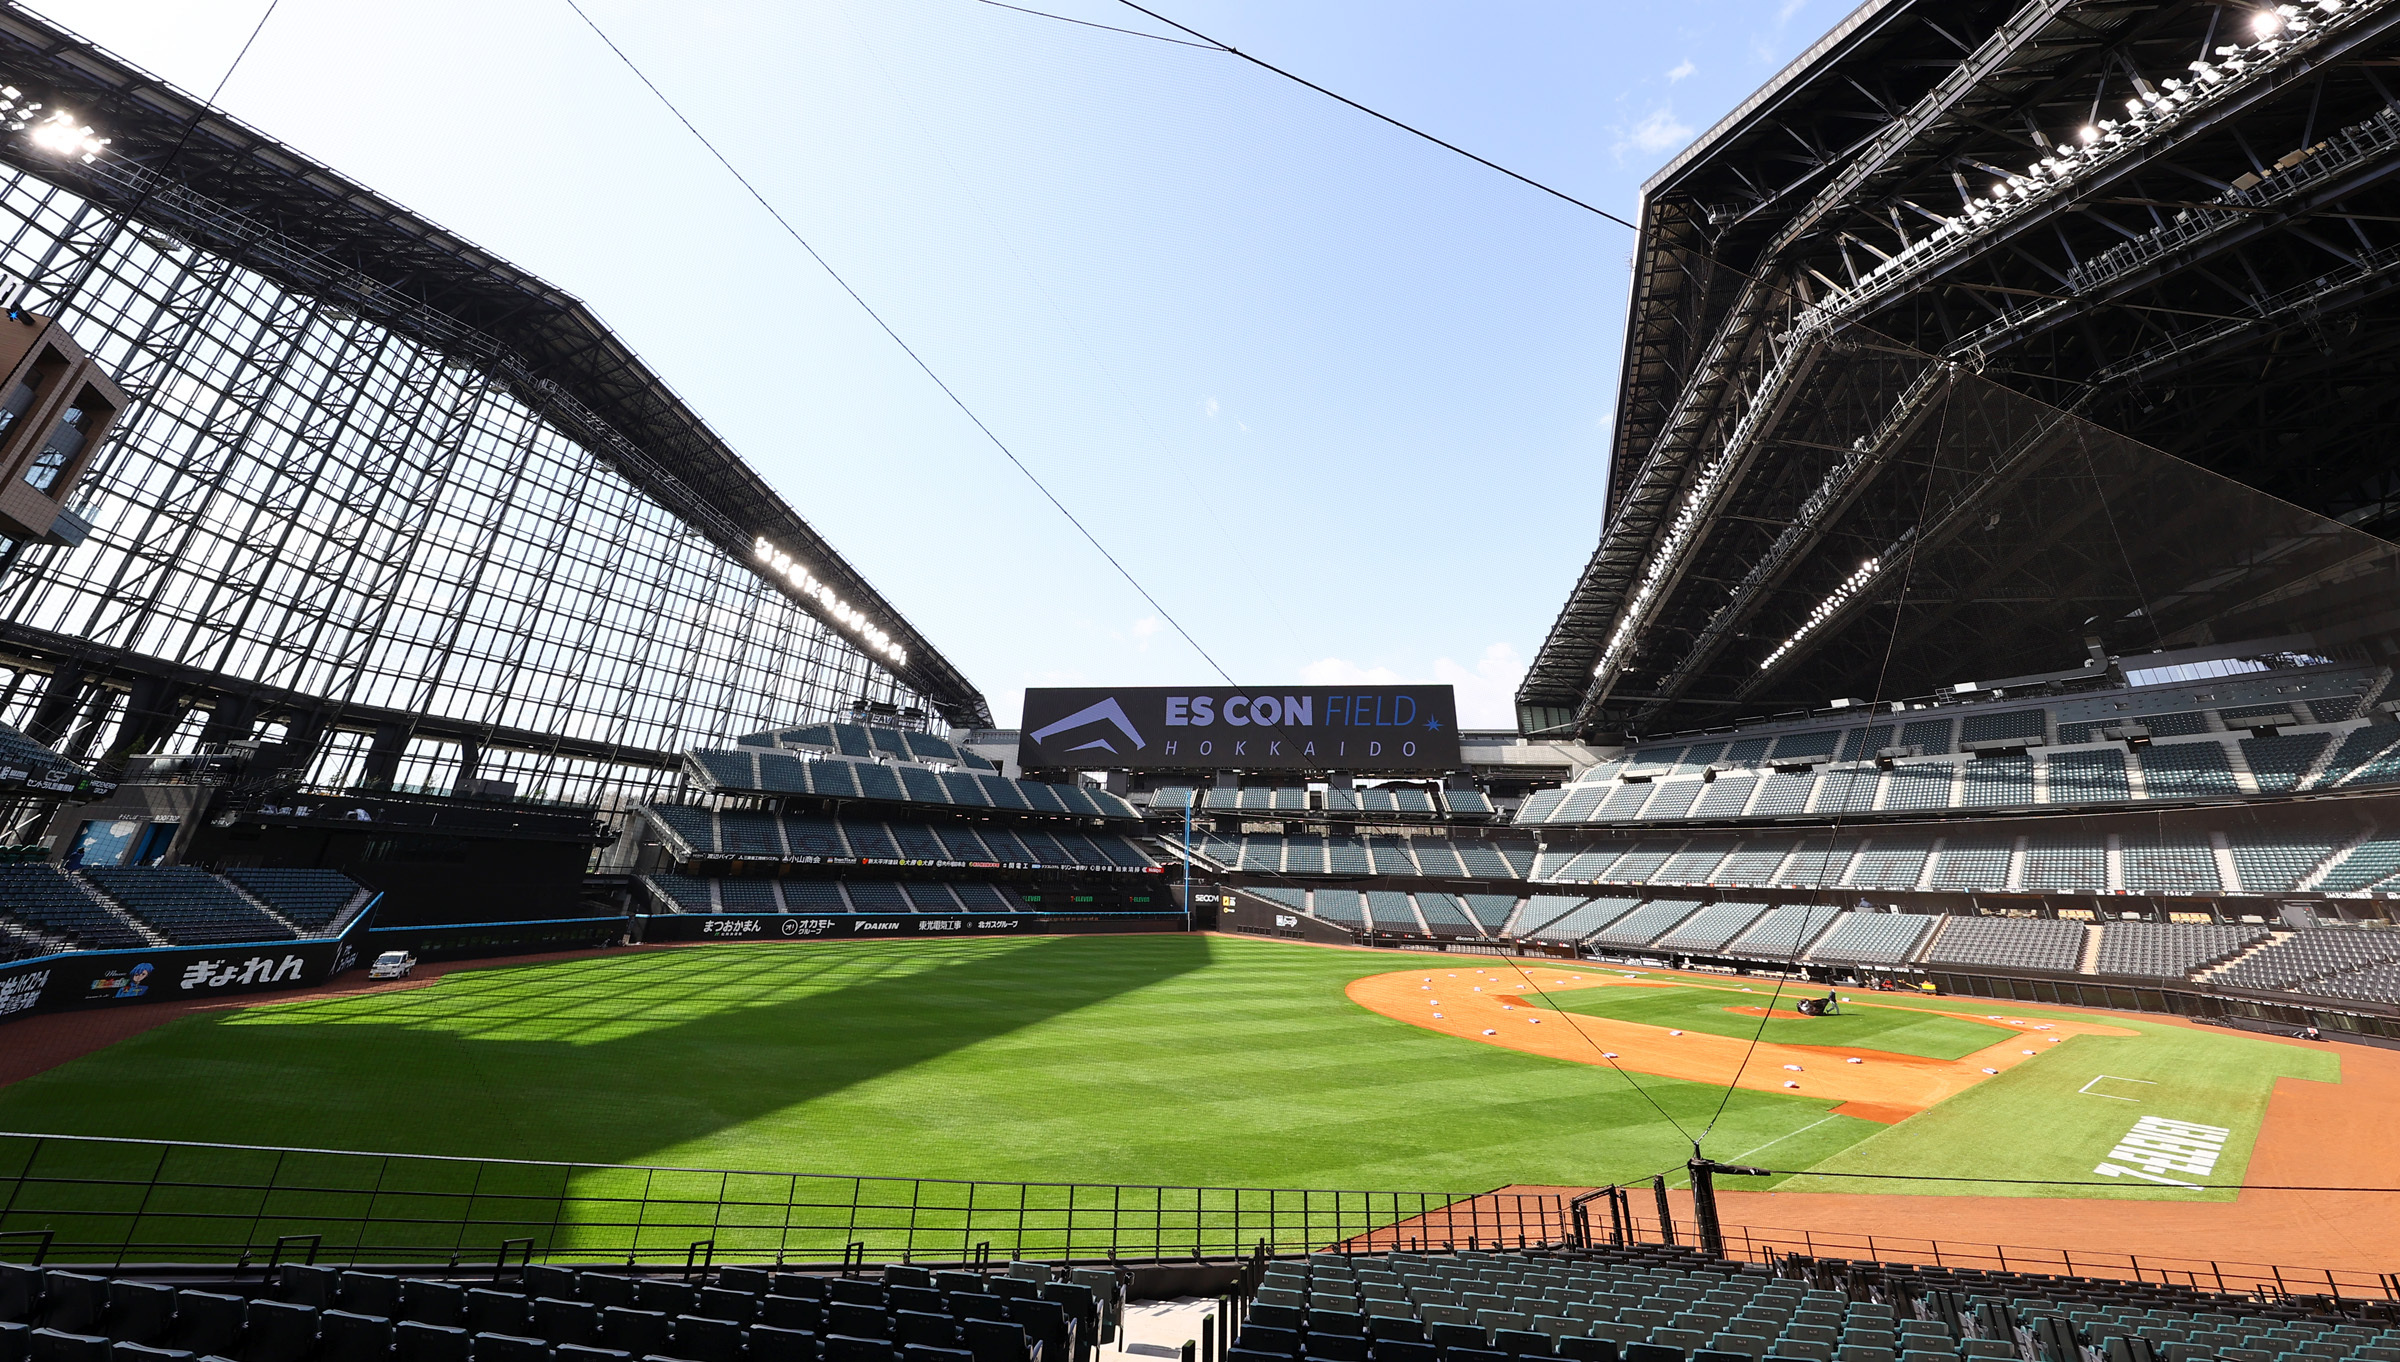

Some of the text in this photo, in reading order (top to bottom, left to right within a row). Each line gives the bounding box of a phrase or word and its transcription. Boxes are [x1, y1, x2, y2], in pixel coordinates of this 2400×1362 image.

[1166, 695, 1416, 727] ES CON FIELD
[1166, 741, 1416, 756] HOKKAIDO
[789, 855, 821, 864] 小山商会
[1195, 894, 1219, 902] SECOM
[703, 919, 761, 933] まつおかまん
[799, 919, 835, 929] オカモト
[864, 922, 900, 930] DAIKIN
[978, 920, 1019, 929] 北ガスグループ
[180, 954, 304, 990] ぎょれん
[2093, 1115, 2231, 1191] 7-ELEVEN
